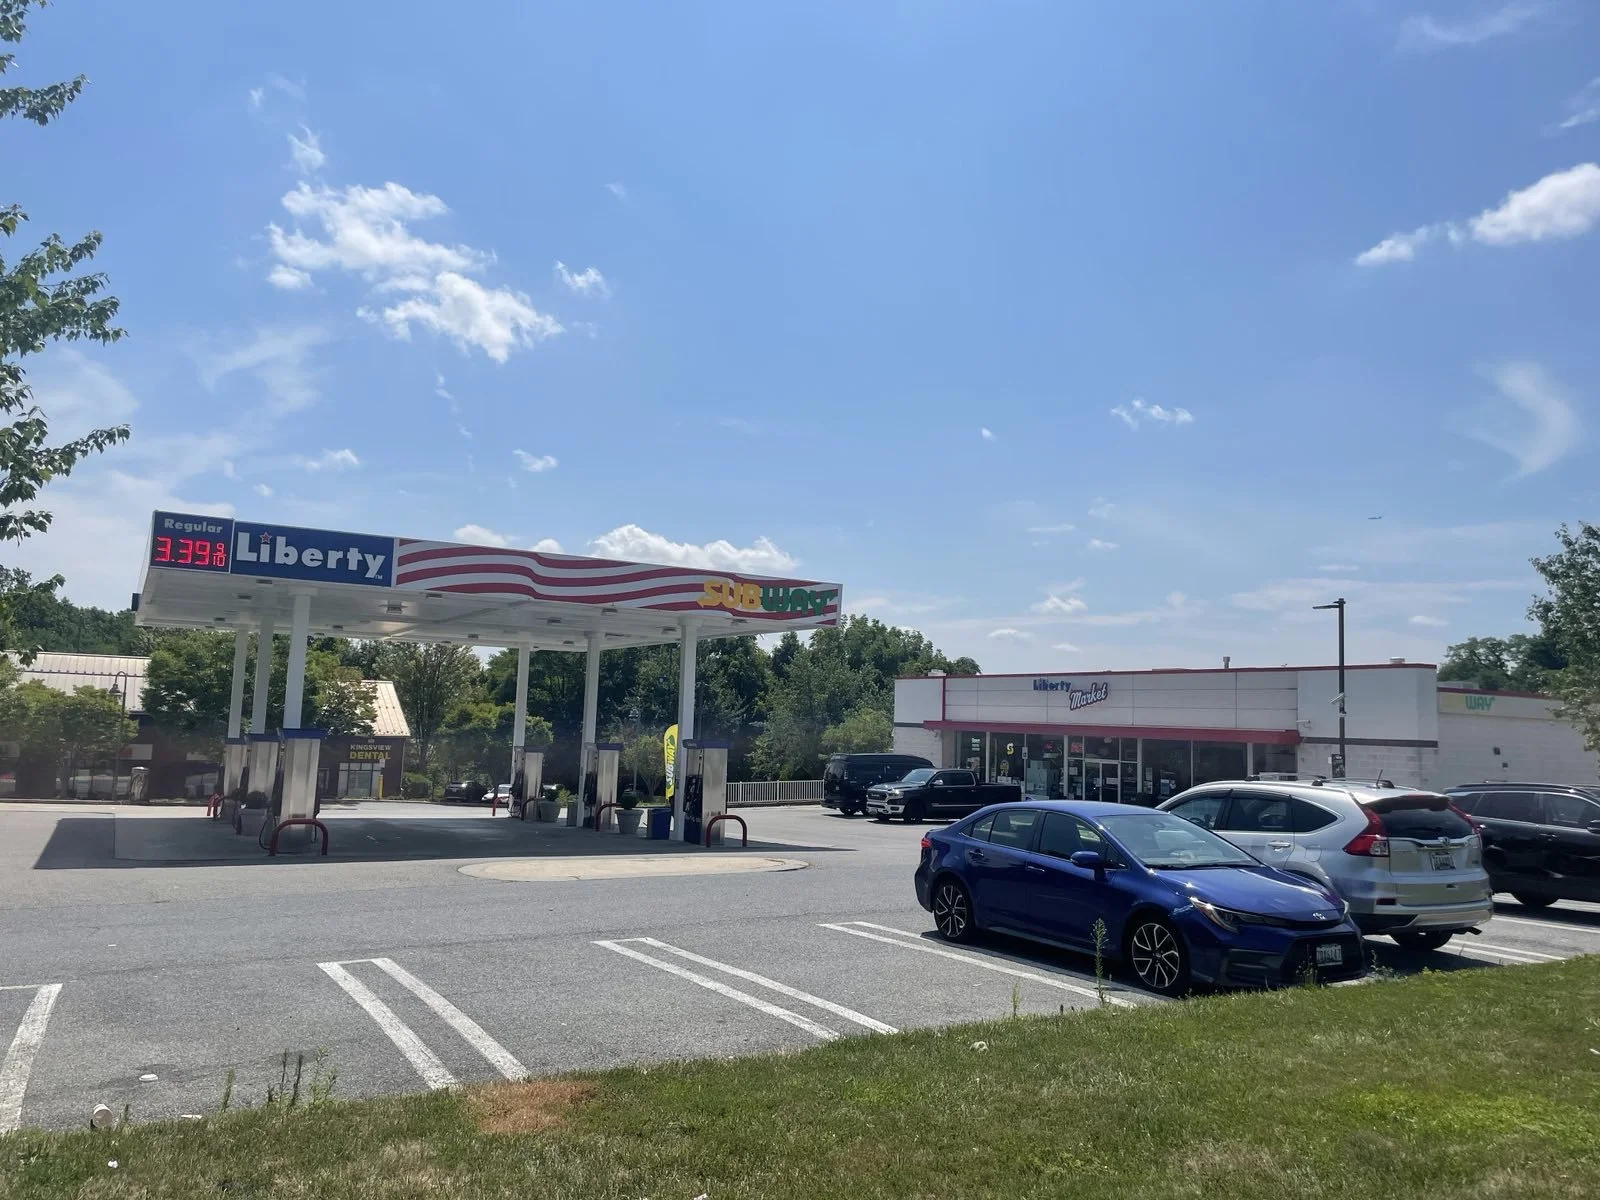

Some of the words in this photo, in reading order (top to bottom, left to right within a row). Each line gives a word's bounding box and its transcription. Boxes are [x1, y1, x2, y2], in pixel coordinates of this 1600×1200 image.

[164, 518, 223, 533] Regular
[236, 531, 386, 578] Liberty
[696, 580, 838, 616] SUBWAY
[1033, 678, 1071, 692] Liberty
[1069, 682, 1108, 711] Market
[349, 751, 391, 760] DENTAL
[665, 740, 677, 786] SUBWAY
